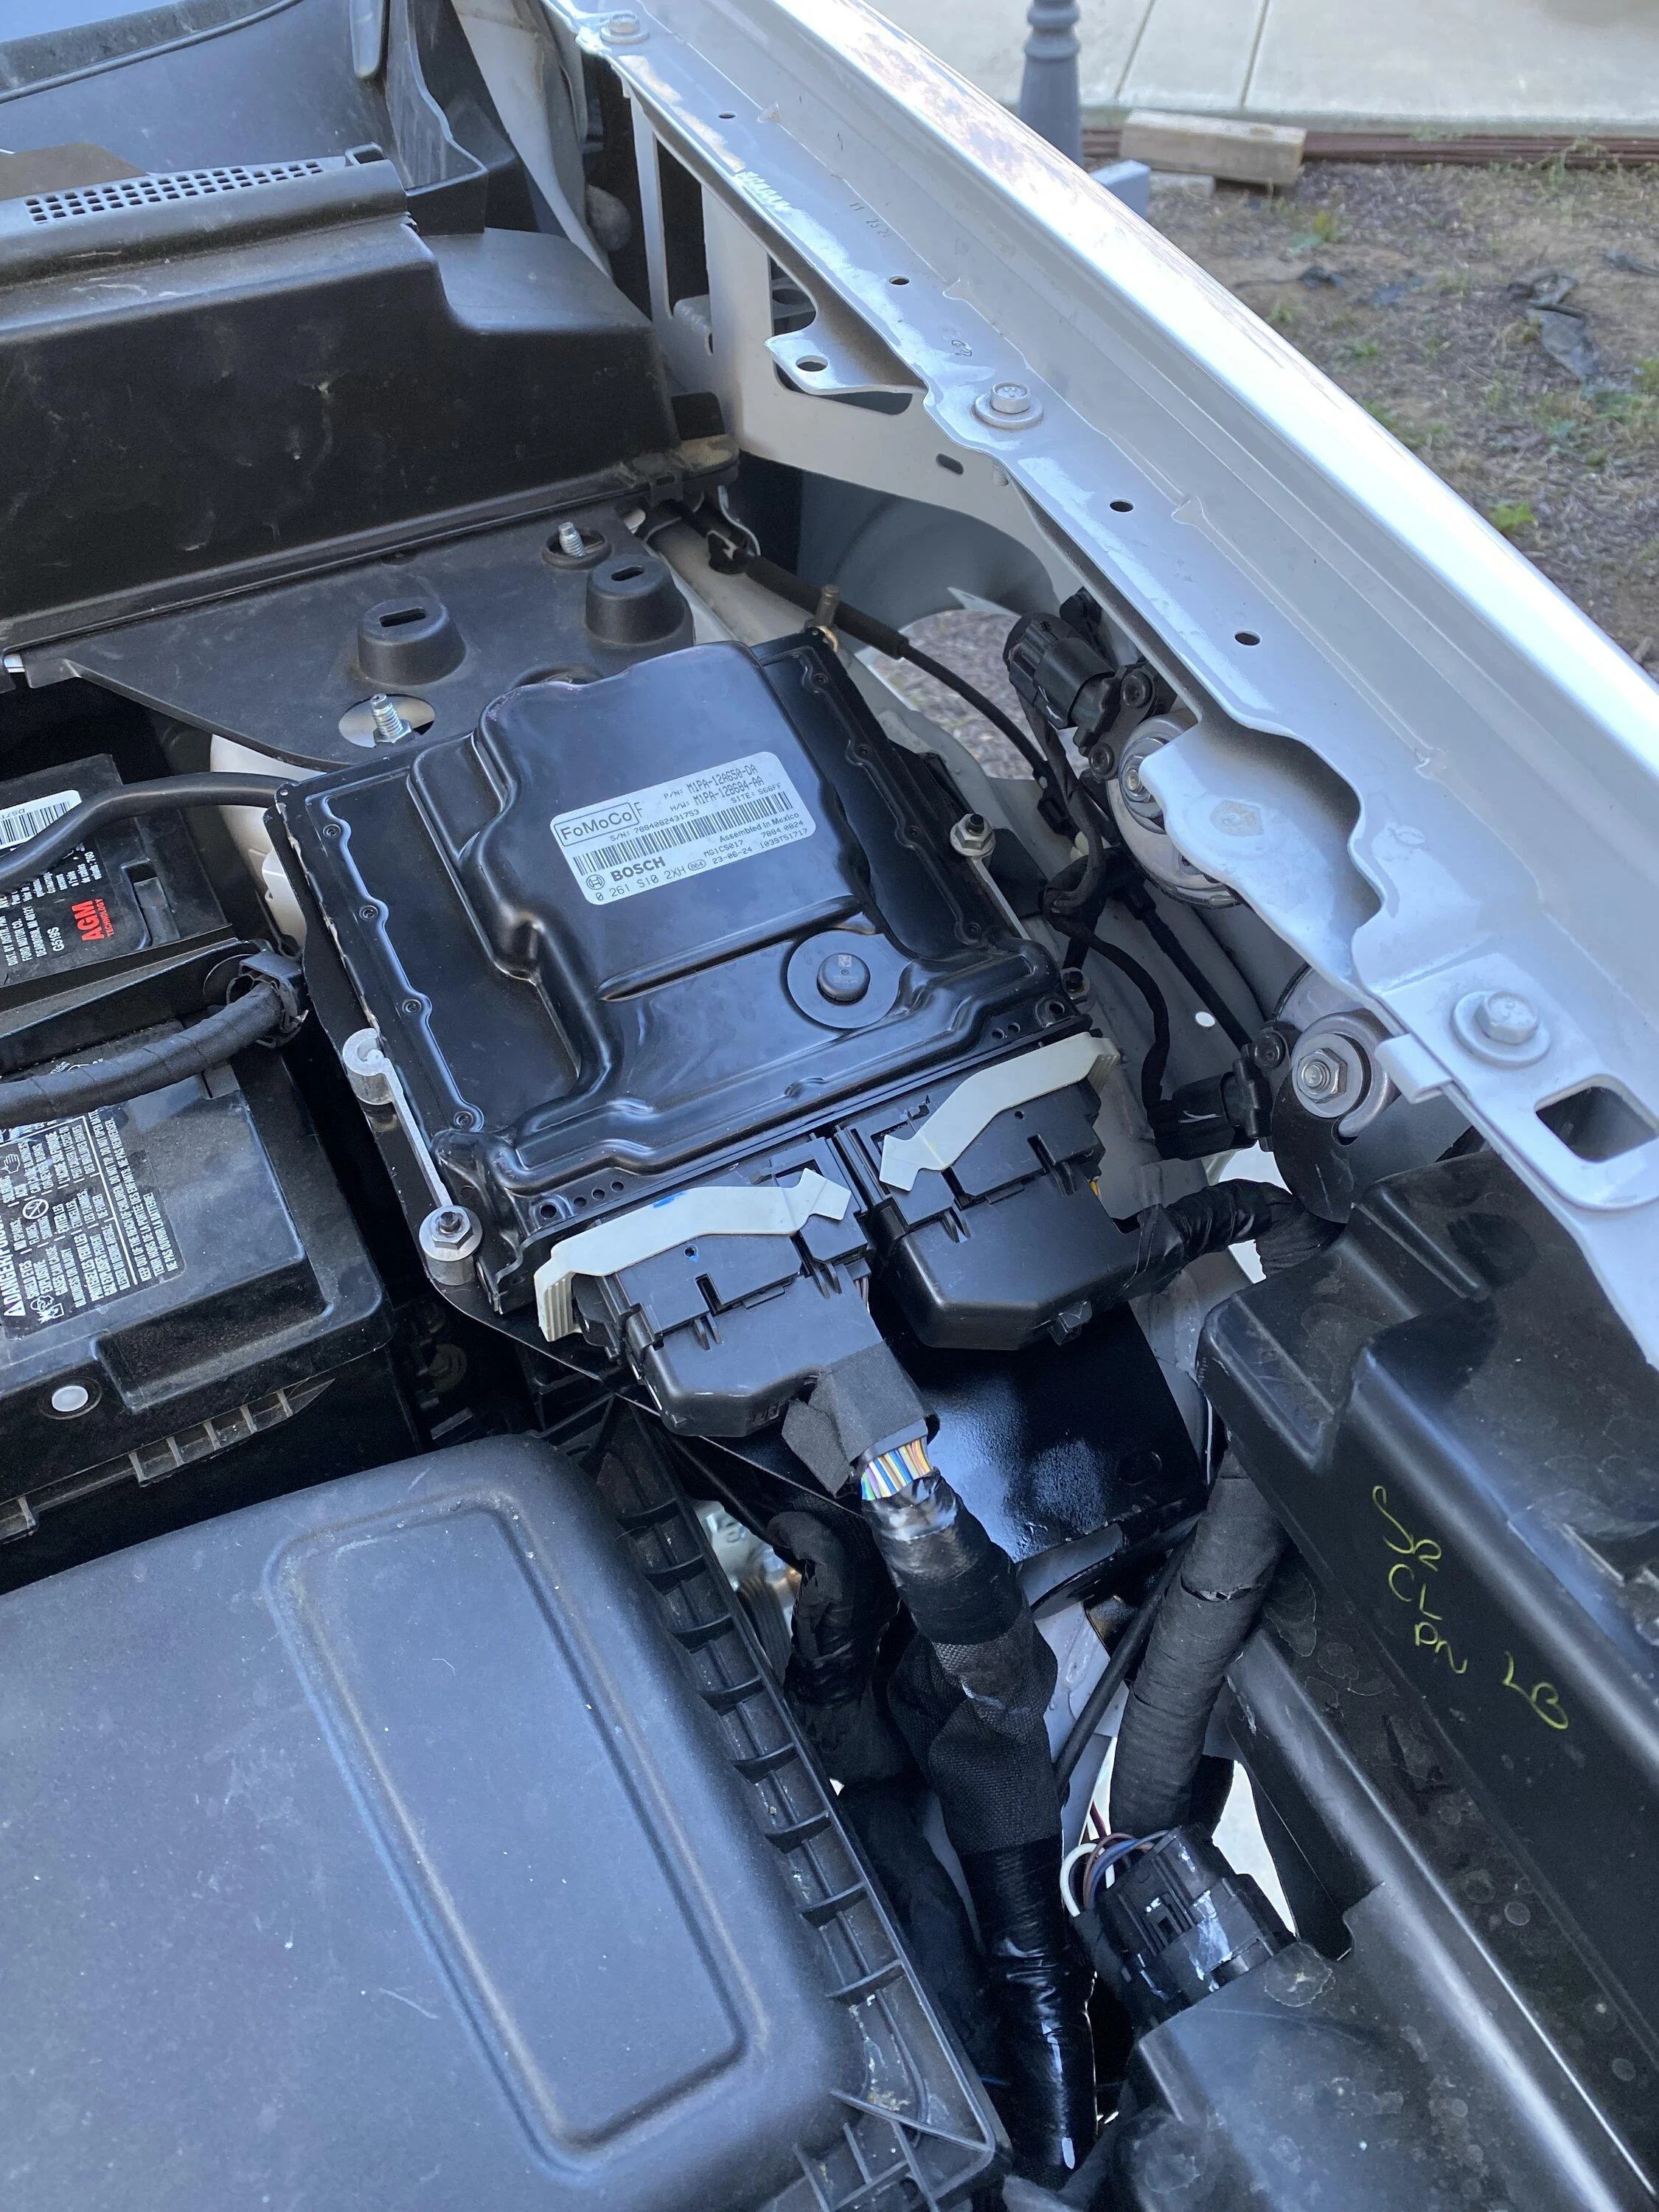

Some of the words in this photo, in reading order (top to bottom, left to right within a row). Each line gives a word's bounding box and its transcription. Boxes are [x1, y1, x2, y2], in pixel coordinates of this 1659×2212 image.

[730, 791, 754, 803] SITE:
[560, 812, 632, 840] FoMoCo
[720, 823, 762, 842] Assembled
[771, 813, 799, 825] Mexico
[712, 846, 752, 864] 23-06-24
[610, 856, 665, 881] BOSCH
[609, 883, 630, 897] 261
[664, 865, 686, 879] 2XH
[11, 918, 23, 928] CO.
[27, 919, 38, 928] MI
[72, 900, 104, 941] AGM
[94, 899, 115, 938] TECHNOLOGY
[13, 928, 28, 947] MOTOR
[29, 927, 47, 957] DEARBORN,
[46, 926, 64, 951] G519S
[2, 944, 14, 952] BY
[18, 946, 32, 961] FORD
[92, 1123, 105, 1138] OPEN
[104, 1116, 122, 1149] RENVERSER.
[63, 1144, 75, 1152] LA
[96, 1136, 108, 1148] NOT
[100, 1146, 111, 1155] DO
[114, 1147, 126, 1160] PAS
[116, 1158, 129, 1167] NE
[53, 1161, 70, 1184] L'ACIDE
[105, 1164, 118, 1176] NOT
[108, 1175, 120, 1184] DO
[120, 1166, 137, 1194] ENFANTS.
[111, 1183, 129, 1211] CHILDREN.
[128, 1192, 142, 1205] DES
[52, 1203, 64, 1214] LES
[97, 1209, 108, 1219] DE
[119, 1211, 132, 1219] OF
[131, 1203, 148, 1226] PORTÉE
[83, 1212, 95, 1224] LES
[151, 1219, 164, 1229] LA
[122, 1217, 137, 1237] REACH
[139, 1223, 151, 1234] LA
[73, 1233, 88, 1246] LES
[128, 1234, 141, 1248] THE
[142, 1231, 153, 1242] DE
[13, 1239, 27, 1251] NO
[76, 1242, 92, 1262] YEUX
[131, 1246, 144, 1256] OF
[144, 1240, 159, 1259] HORS
[45, 1244, 60, 1265] CAUSE
[60, 1248, 75, 1269] INJURY
[133, 1253, 147, 1267] OUT
[161, 1248, 175, 1262] PAS
[18, 1259, 34, 1278] EYES
[49, 1262, 63, 1276] CAN
[66, 1266, 77, 1277] OR
[80, 1259, 95, 1272] LES
[94, 1253, 114, 1284] EXPLOSIFS
[150, 1256, 164, 1276] TENIR
[165, 1260, 178, 1271] NE
[32, 1259, 53, 1294] EXPLOSIVE
[138, 1267, 152, 1281] KEEP
[22, 1276, 40, 1299] SHIELD
[51, 1273, 68, 1295] GASES
[68, 1275, 86, 1307] BLINDNESS
[102, 1281, 117, 1295] GAZ
